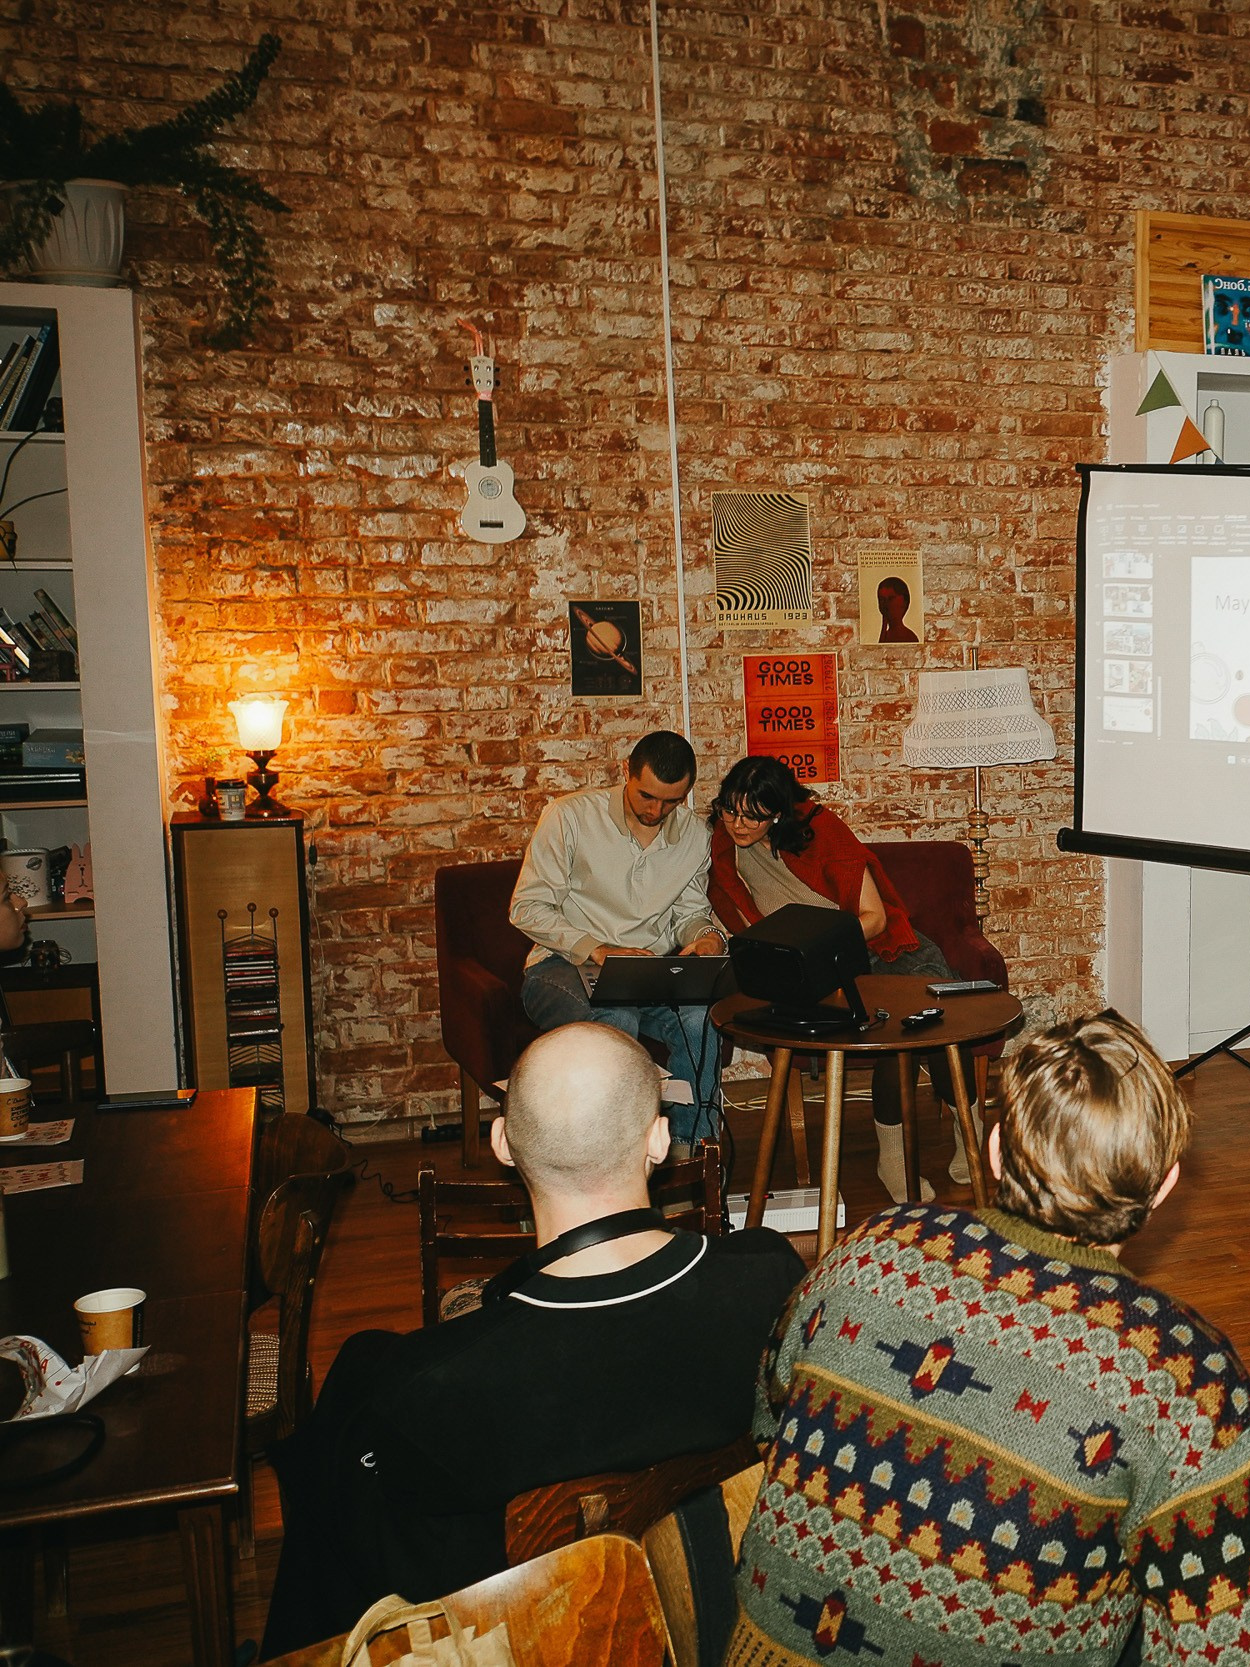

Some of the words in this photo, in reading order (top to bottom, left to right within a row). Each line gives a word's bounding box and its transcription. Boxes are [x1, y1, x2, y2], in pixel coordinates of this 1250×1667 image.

[1215, 595, 1250, 614] May
[718, 612, 767, 621] BAUHAUS
[784, 612, 808, 620] 1923
[758, 661, 811, 674] GOOD
[757, 673, 814, 686] TIMES
[760, 706, 812, 719] GOOD
[758, 718, 816, 732] TIMES
[779, 754, 815, 766] OOD
